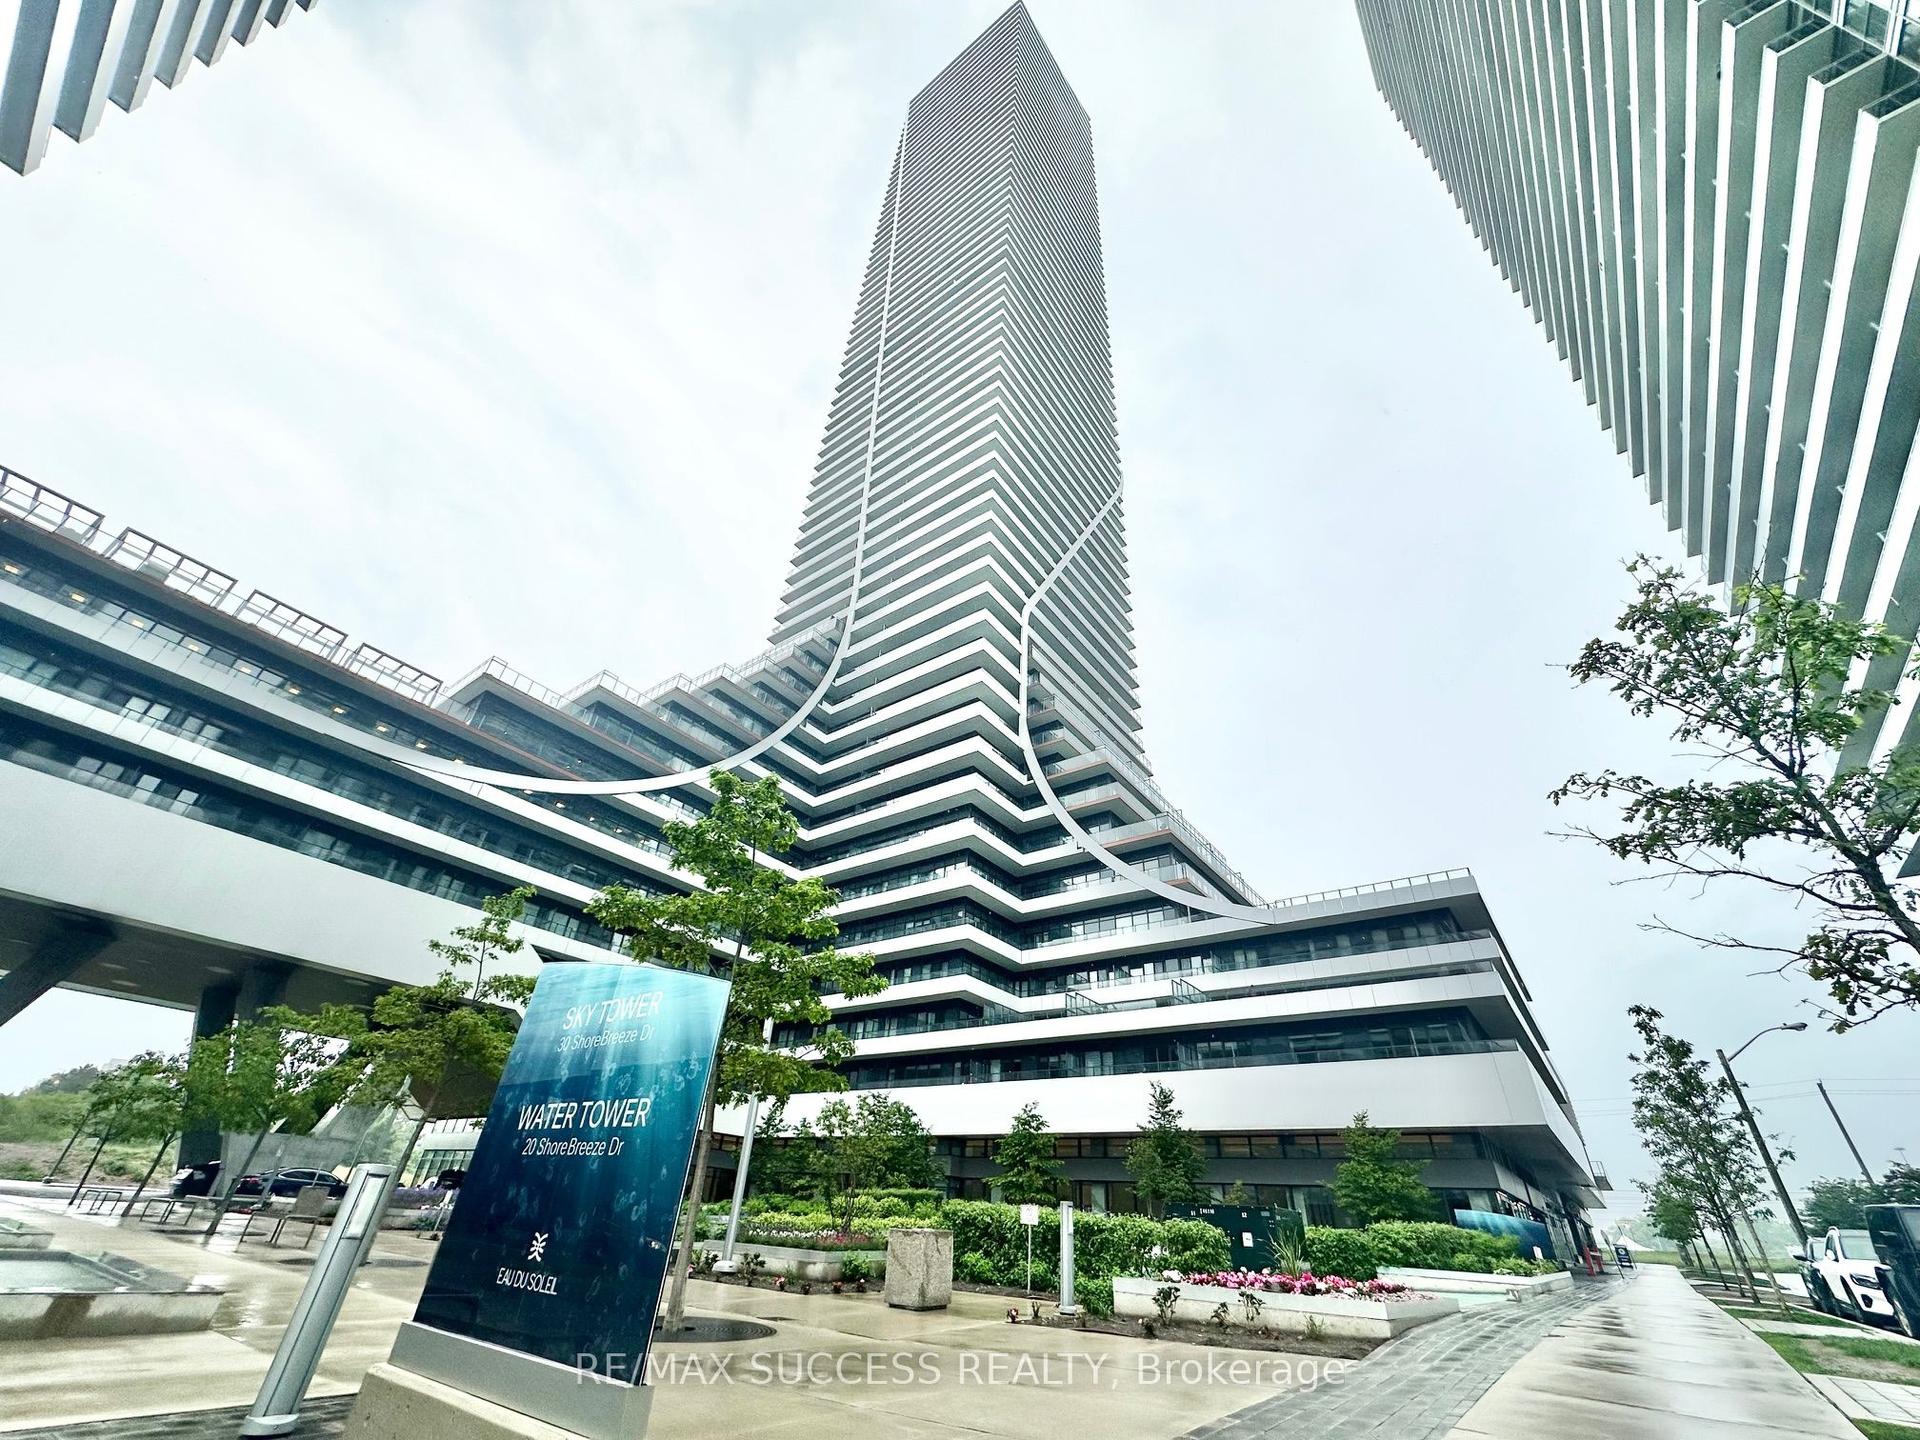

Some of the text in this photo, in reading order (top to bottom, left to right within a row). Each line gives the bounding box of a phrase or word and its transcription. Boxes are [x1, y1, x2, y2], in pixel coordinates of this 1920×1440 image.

[563, 991, 663, 1030] SKY TOWER
[556, 1024, 655, 1053] 30 ShoreBreeze Dr
[517, 1097, 651, 1130] WATER TOWER
[522, 1136, 625, 1156] 20 ShoreBreeze Dr
[496, 1267, 516, 1286] EAU
[513, 1270, 529, 1288] DU
